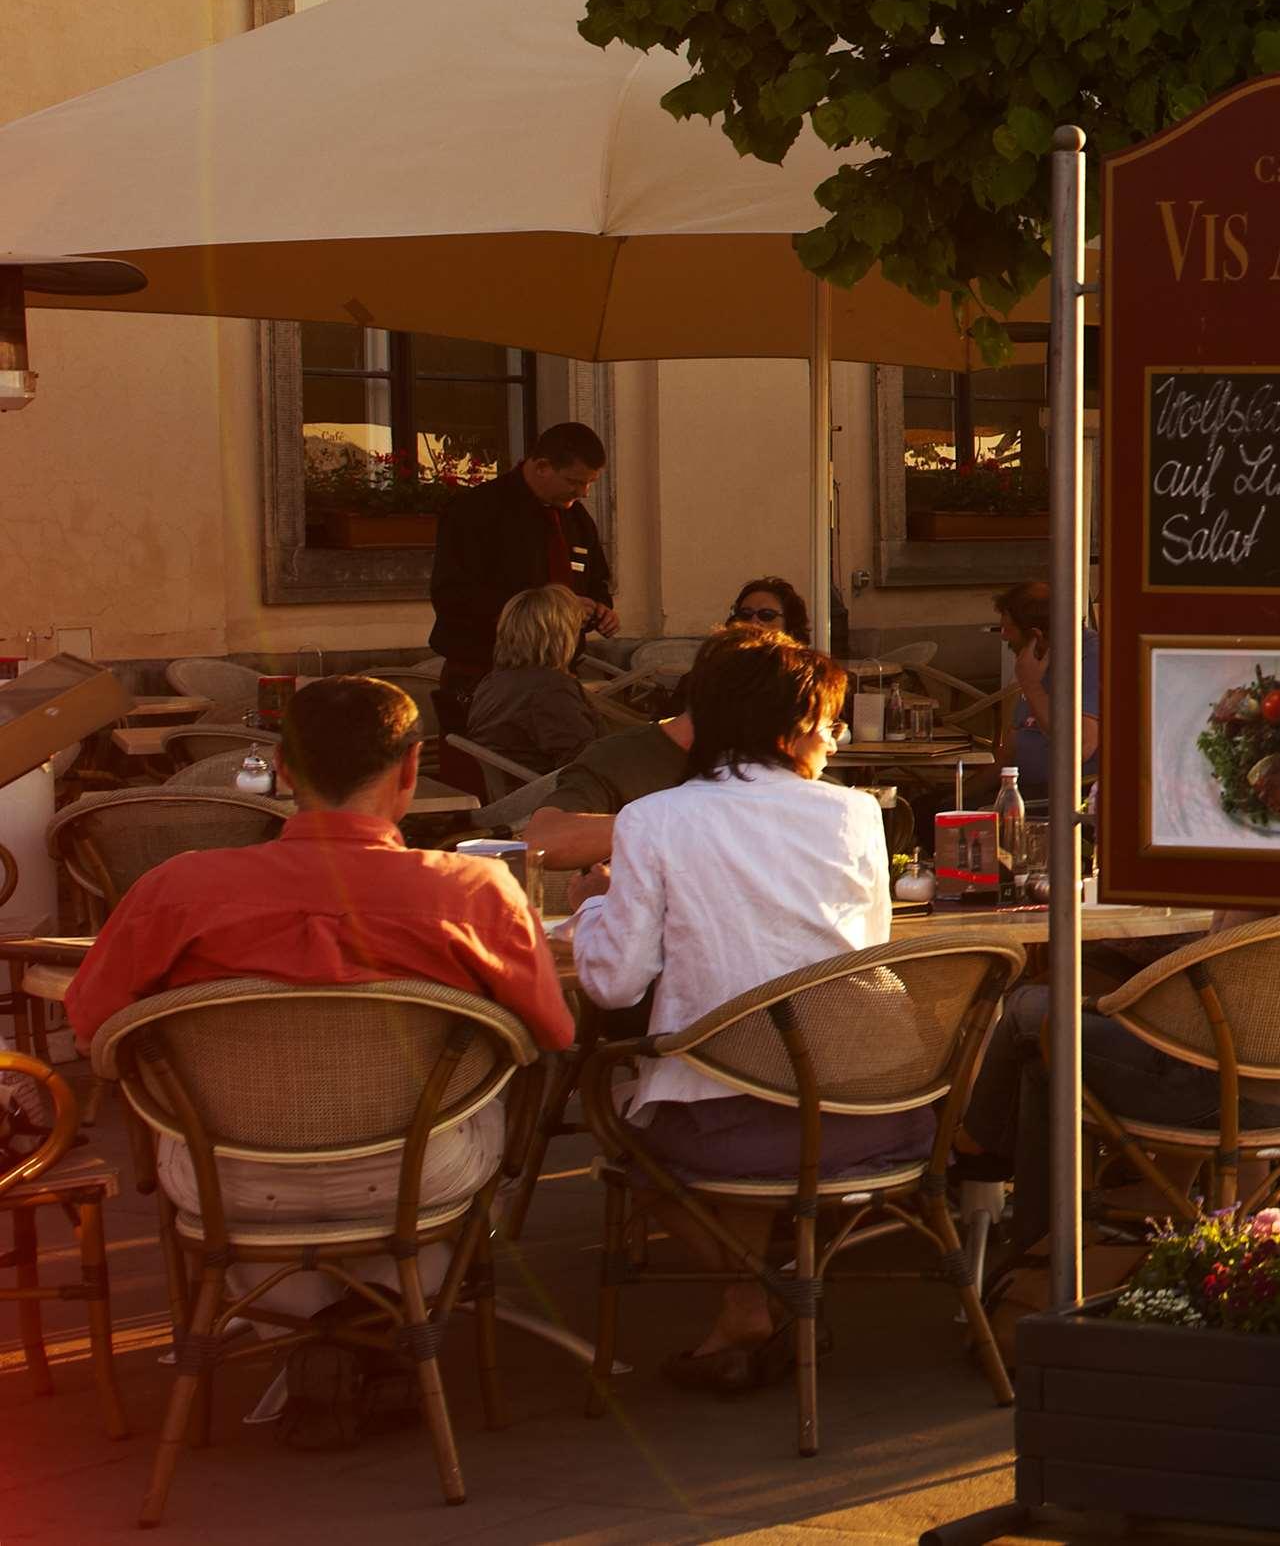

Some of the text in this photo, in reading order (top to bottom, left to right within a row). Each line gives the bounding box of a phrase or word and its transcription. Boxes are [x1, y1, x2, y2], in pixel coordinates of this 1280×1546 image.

[1155, 201, 1250, 282] VIS
[1154, 444, 1224, 515] auf
[1162, 505, 1265, 564] Salat
